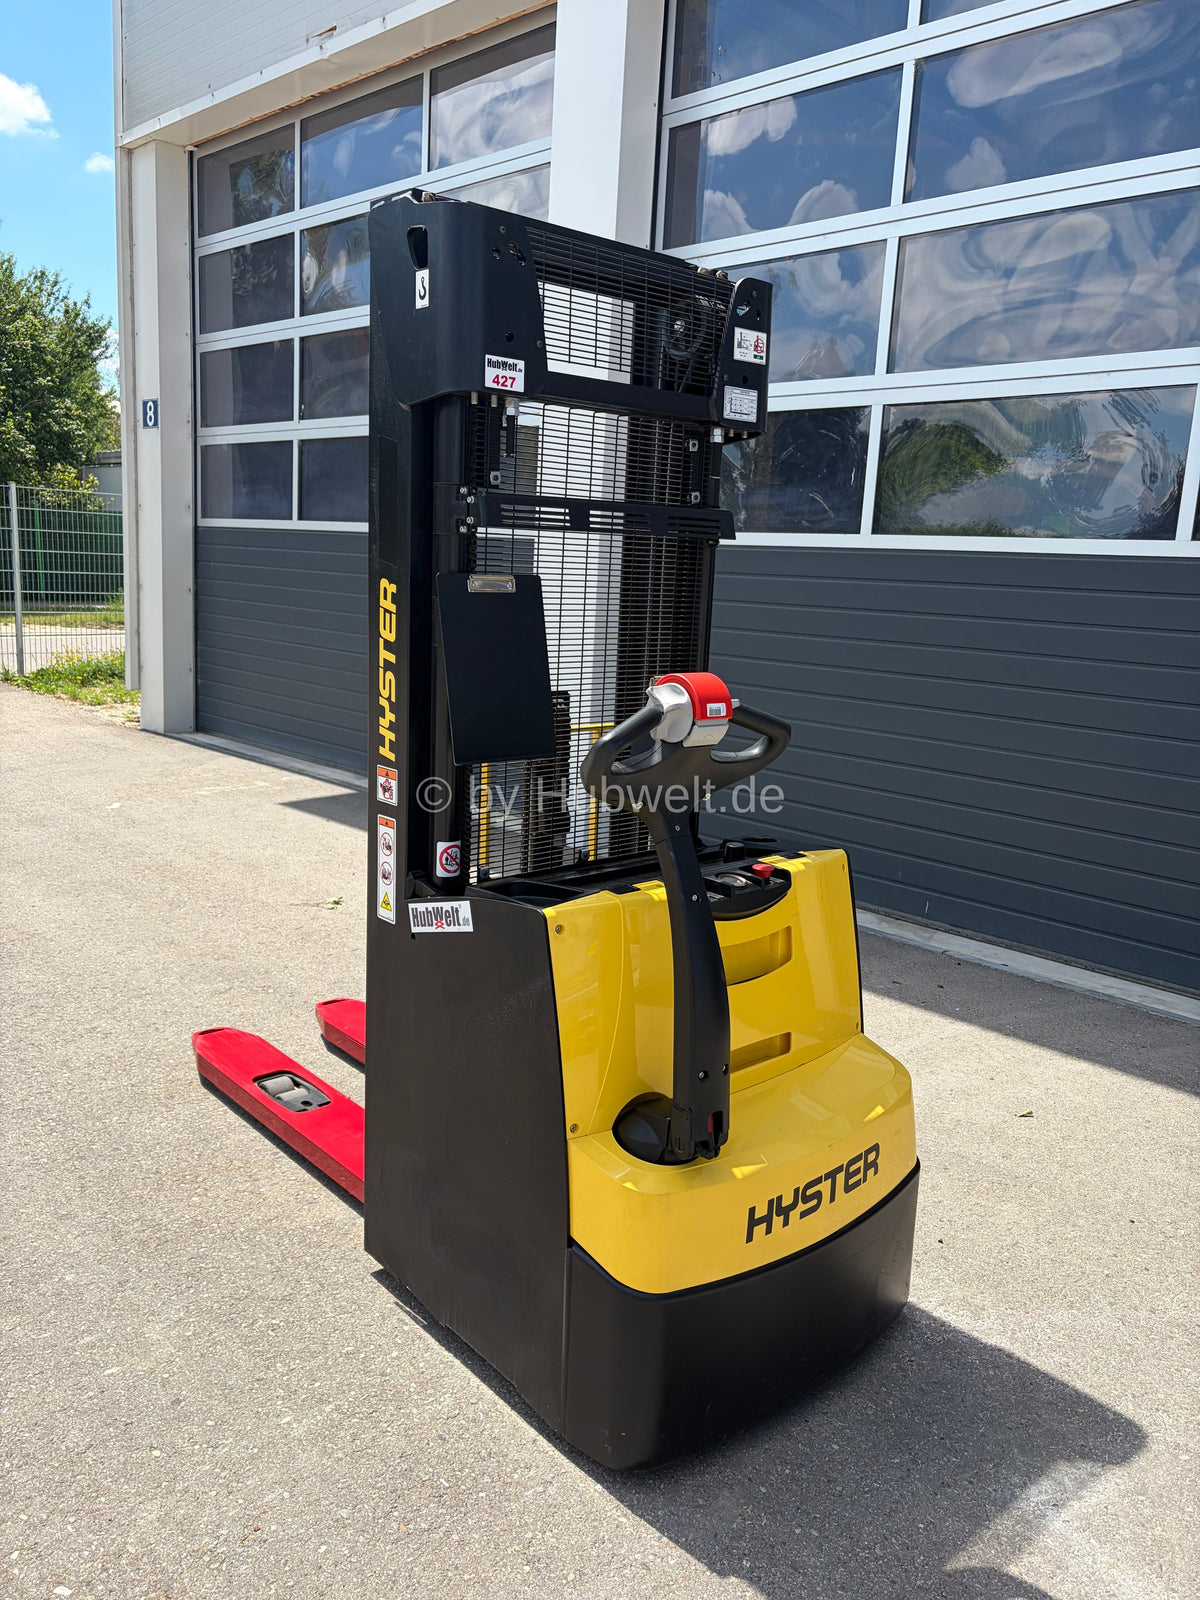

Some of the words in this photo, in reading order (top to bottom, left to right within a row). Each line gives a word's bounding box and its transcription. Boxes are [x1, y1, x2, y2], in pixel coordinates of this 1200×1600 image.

[492, 374, 516, 389] 427
[146, 401, 155, 427] 8
[378, 577, 397, 762] HYSTER
[745, 1142, 881, 1244] HYSTER
